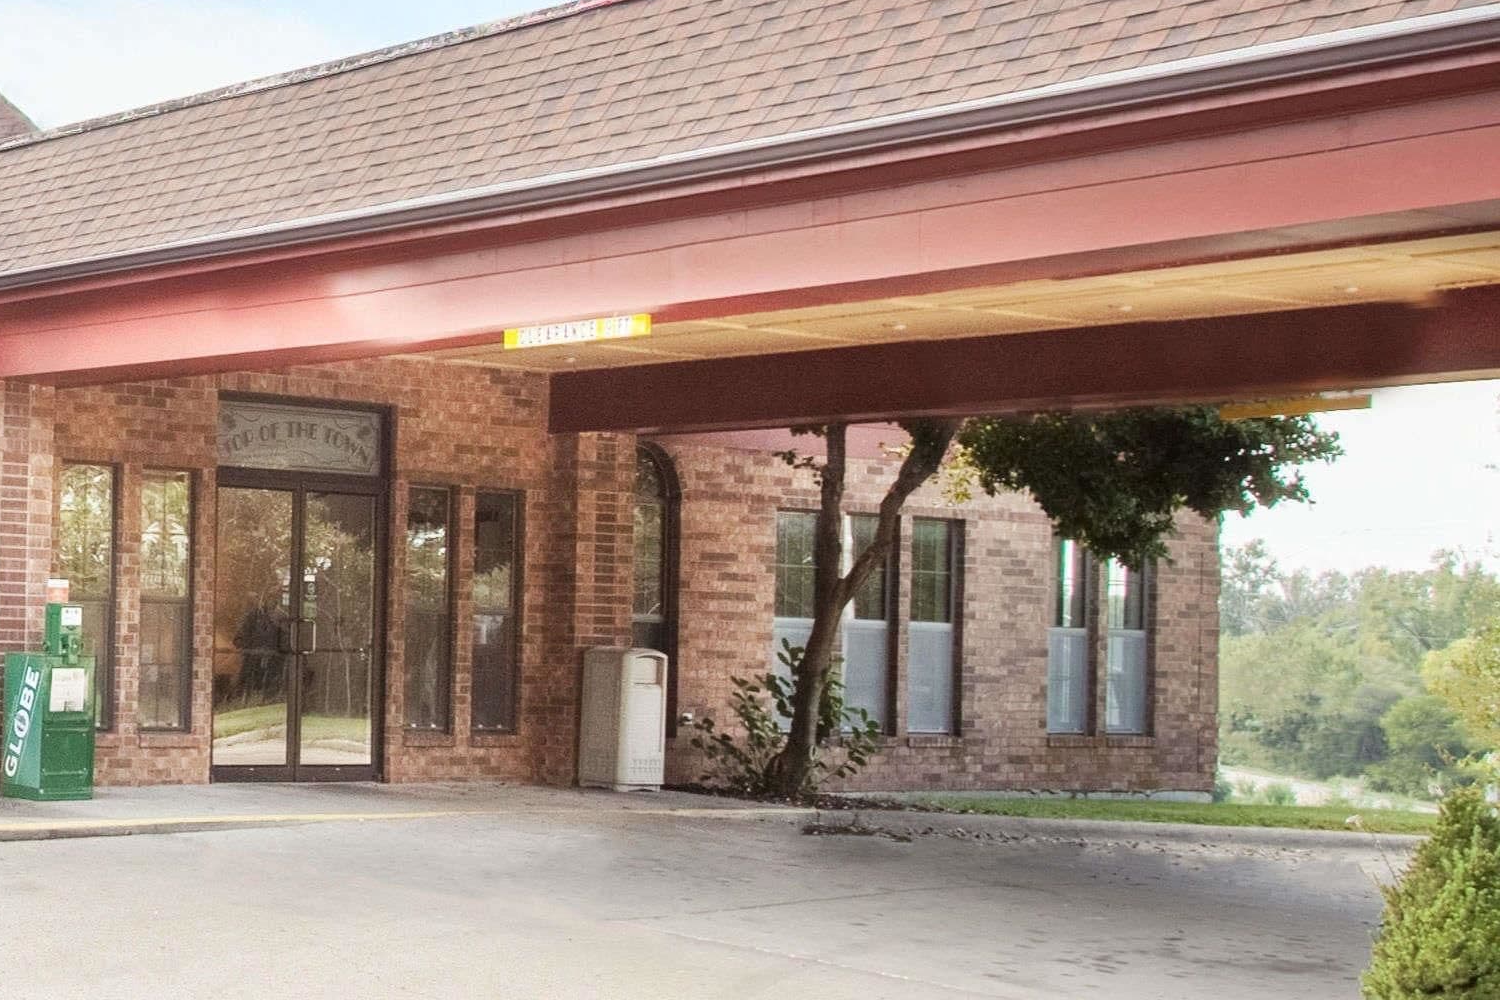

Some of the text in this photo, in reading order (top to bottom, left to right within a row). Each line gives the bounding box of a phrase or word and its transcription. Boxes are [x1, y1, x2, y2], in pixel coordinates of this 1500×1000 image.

[518, 320, 596, 345] CLEARANCE
[218, 420, 373, 466] TOP OF THE TOWN
[4, 666, 40, 778] GLOBE
